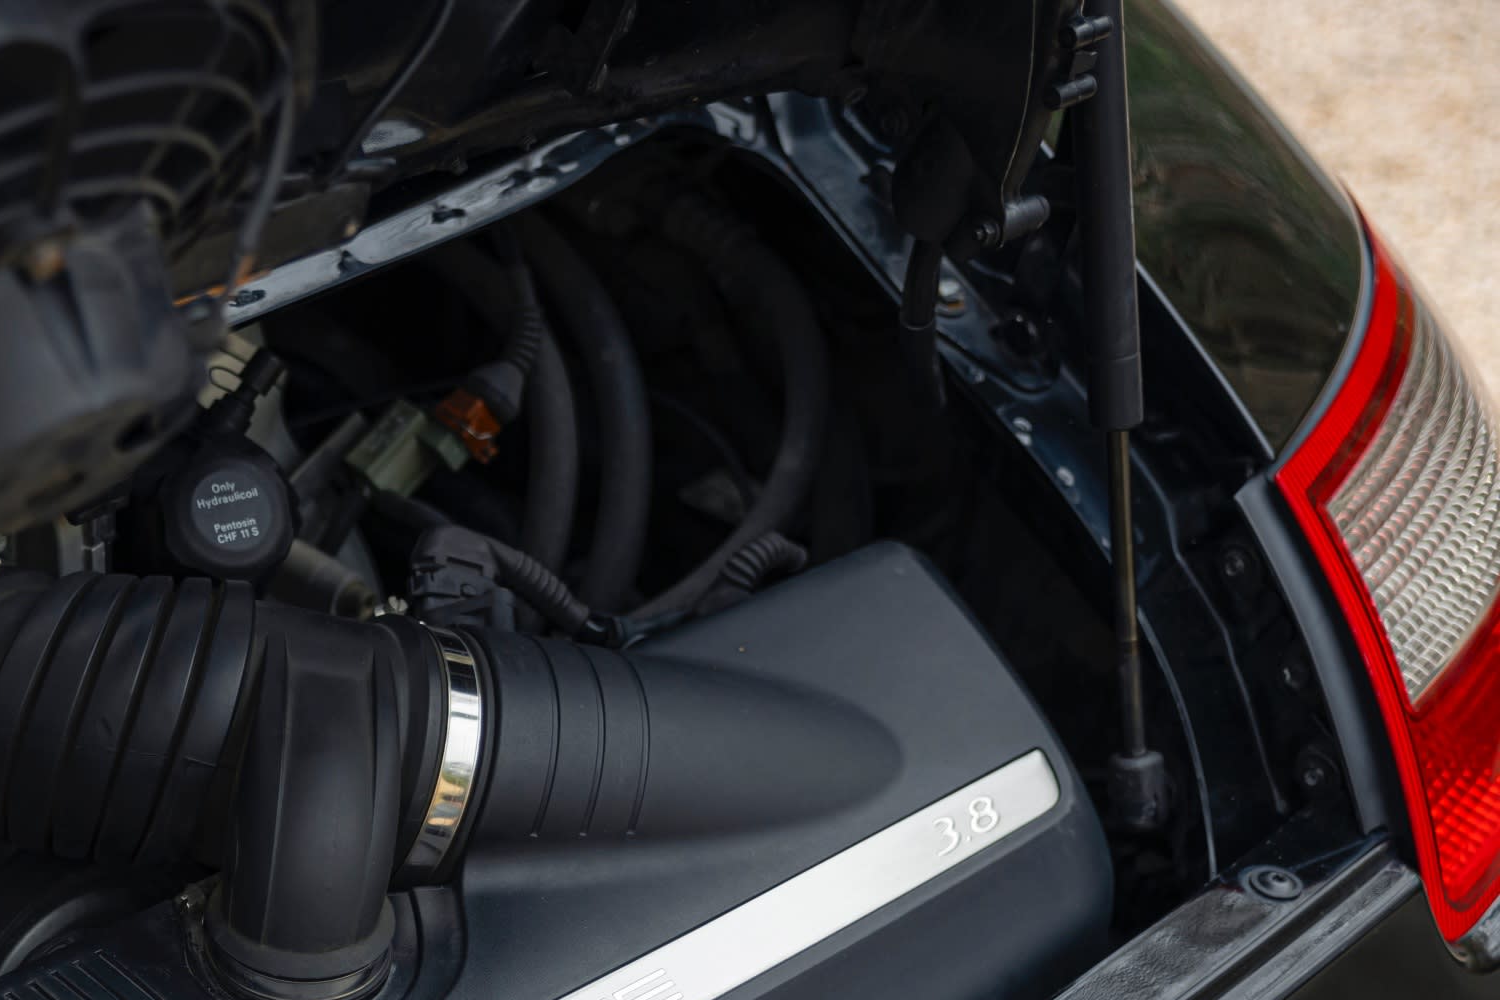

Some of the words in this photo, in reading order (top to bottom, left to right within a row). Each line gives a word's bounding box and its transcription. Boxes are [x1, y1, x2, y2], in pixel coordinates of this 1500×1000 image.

[211, 481, 235, 494] Only
[196, 487, 259, 509] Hydraulicoil
[213, 517, 257, 534] Pentosin
[217, 531, 237, 544] CHF
[240, 528, 250, 539] 11
[251, 526, 260, 537] S
[933, 796, 999, 857] 3.8
